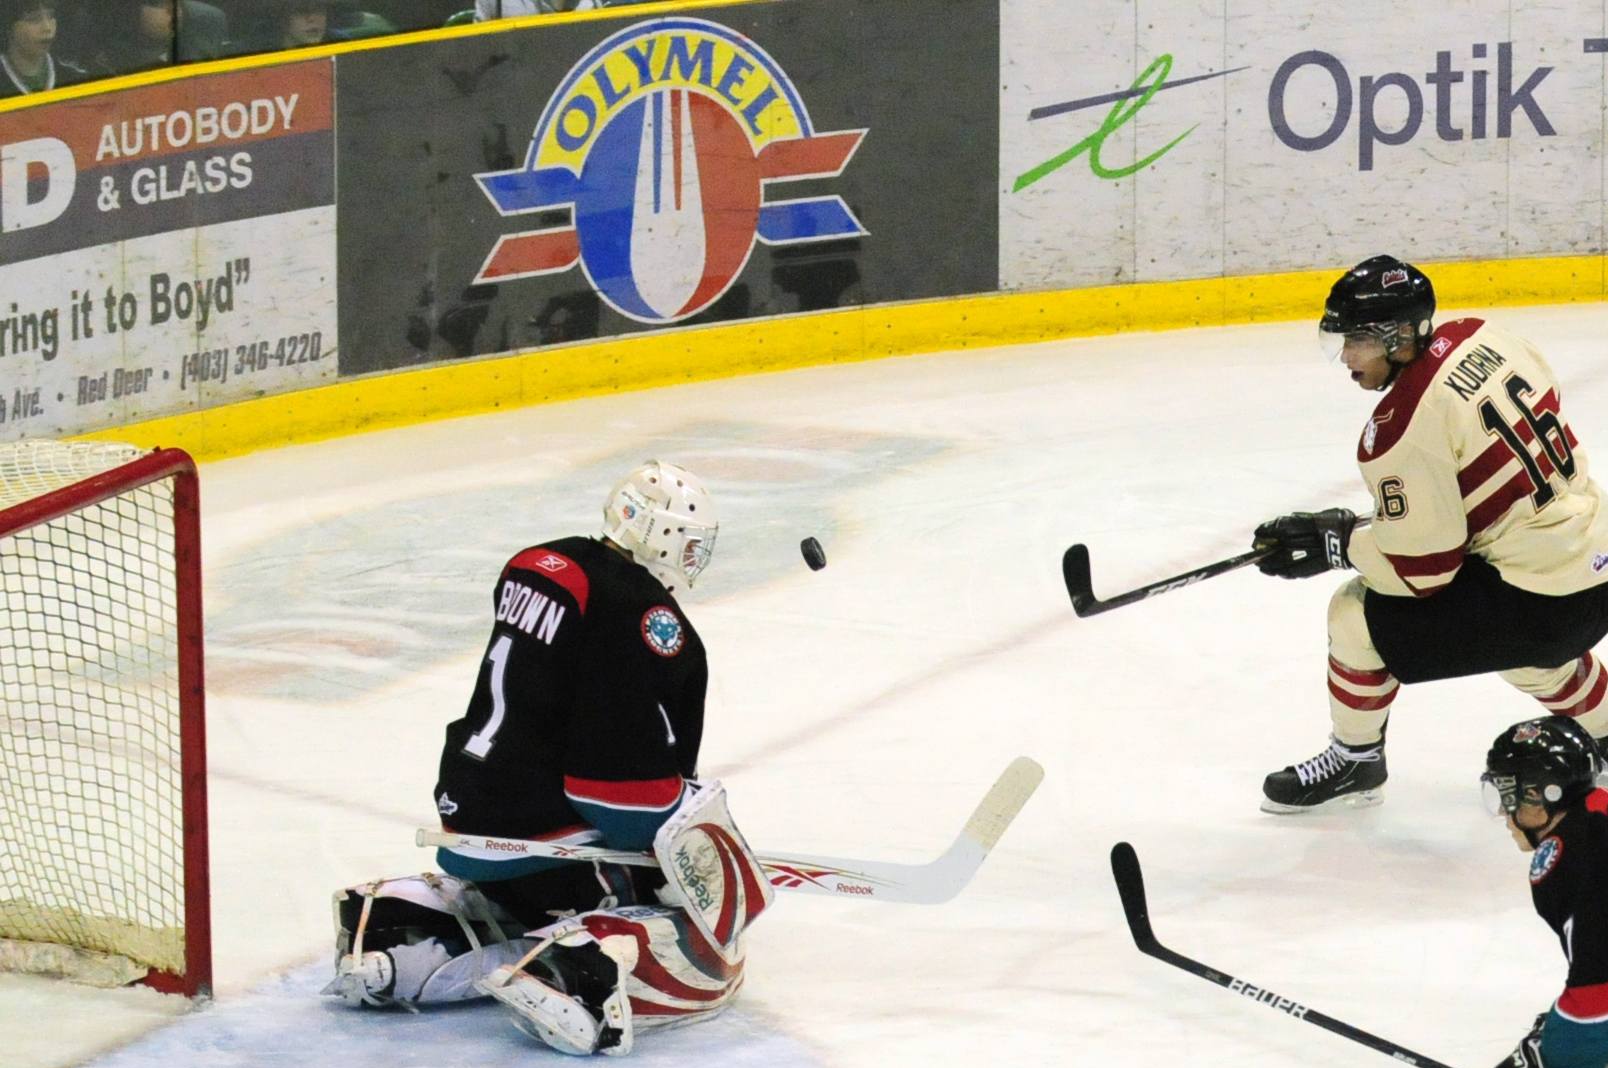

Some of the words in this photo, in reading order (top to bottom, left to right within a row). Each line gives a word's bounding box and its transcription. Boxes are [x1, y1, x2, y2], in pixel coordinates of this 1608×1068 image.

[555, 36, 780, 151] OLYMEL
[1266, 42, 1557, 171] Optik
[96, 94, 299, 161] AUTOBODY
[96, 175, 121, 212] &
[131, 151, 253, 206] GLASS
[71, 290, 93, 341] it
[104, 286, 137, 334] to
[12, 386, 44, 421] Ave.
[77, 373, 108, 406] Red
[113, 367, 153, 400] Deer
[234, 331, 322, 376] 346-4220
[1478, 370, 1577, 514] 16
[1374, 474, 1409, 522] 6
[462, 634, 514, 761] 1
[484, 839, 529, 854] Reebok
[675, 845, 714, 912] Reebok
[836, 882, 875, 896] Reebok
